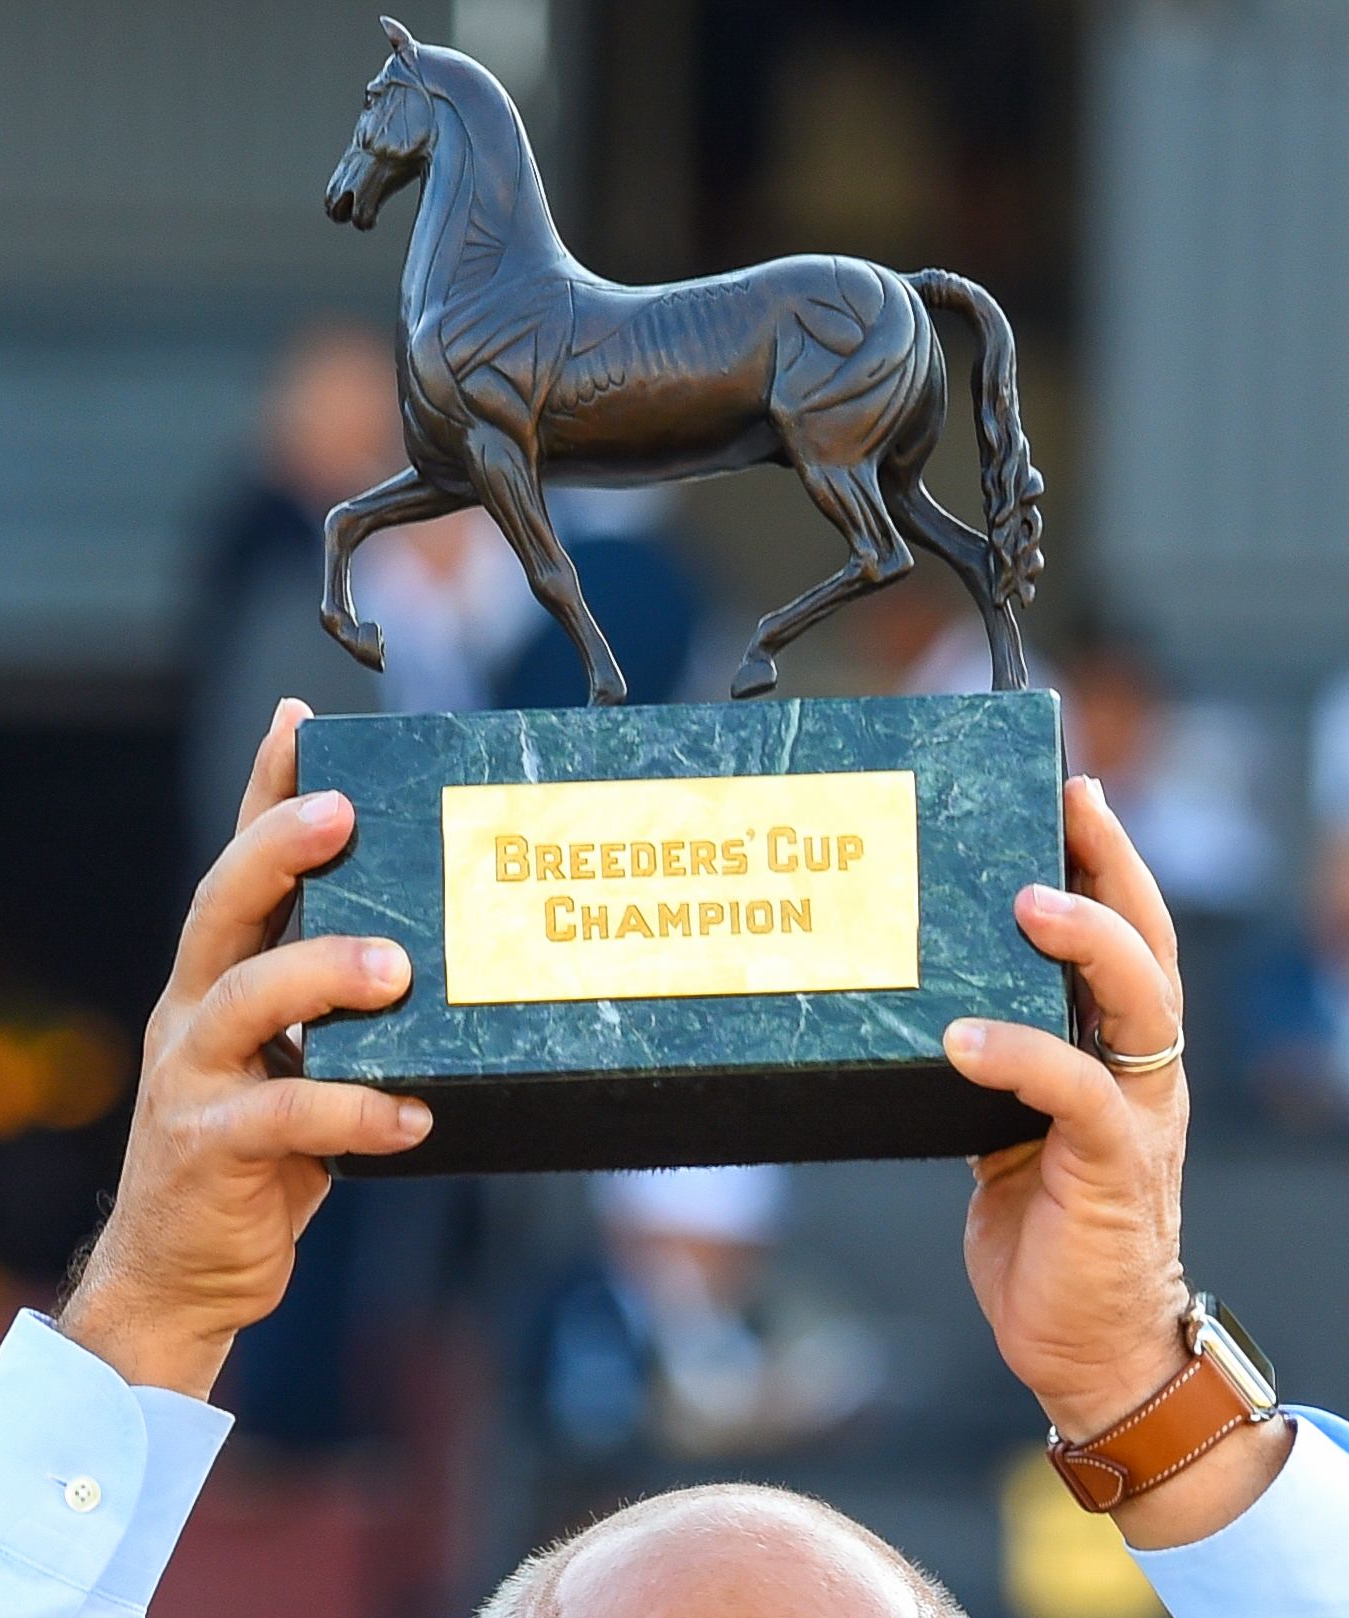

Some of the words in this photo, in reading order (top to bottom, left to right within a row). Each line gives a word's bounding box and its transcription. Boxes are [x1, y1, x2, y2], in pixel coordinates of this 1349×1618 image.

[495, 829, 755, 882] BREEDERS'
[767, 826, 864, 873] CUP
[545, 896, 812, 942] CHAMPION
